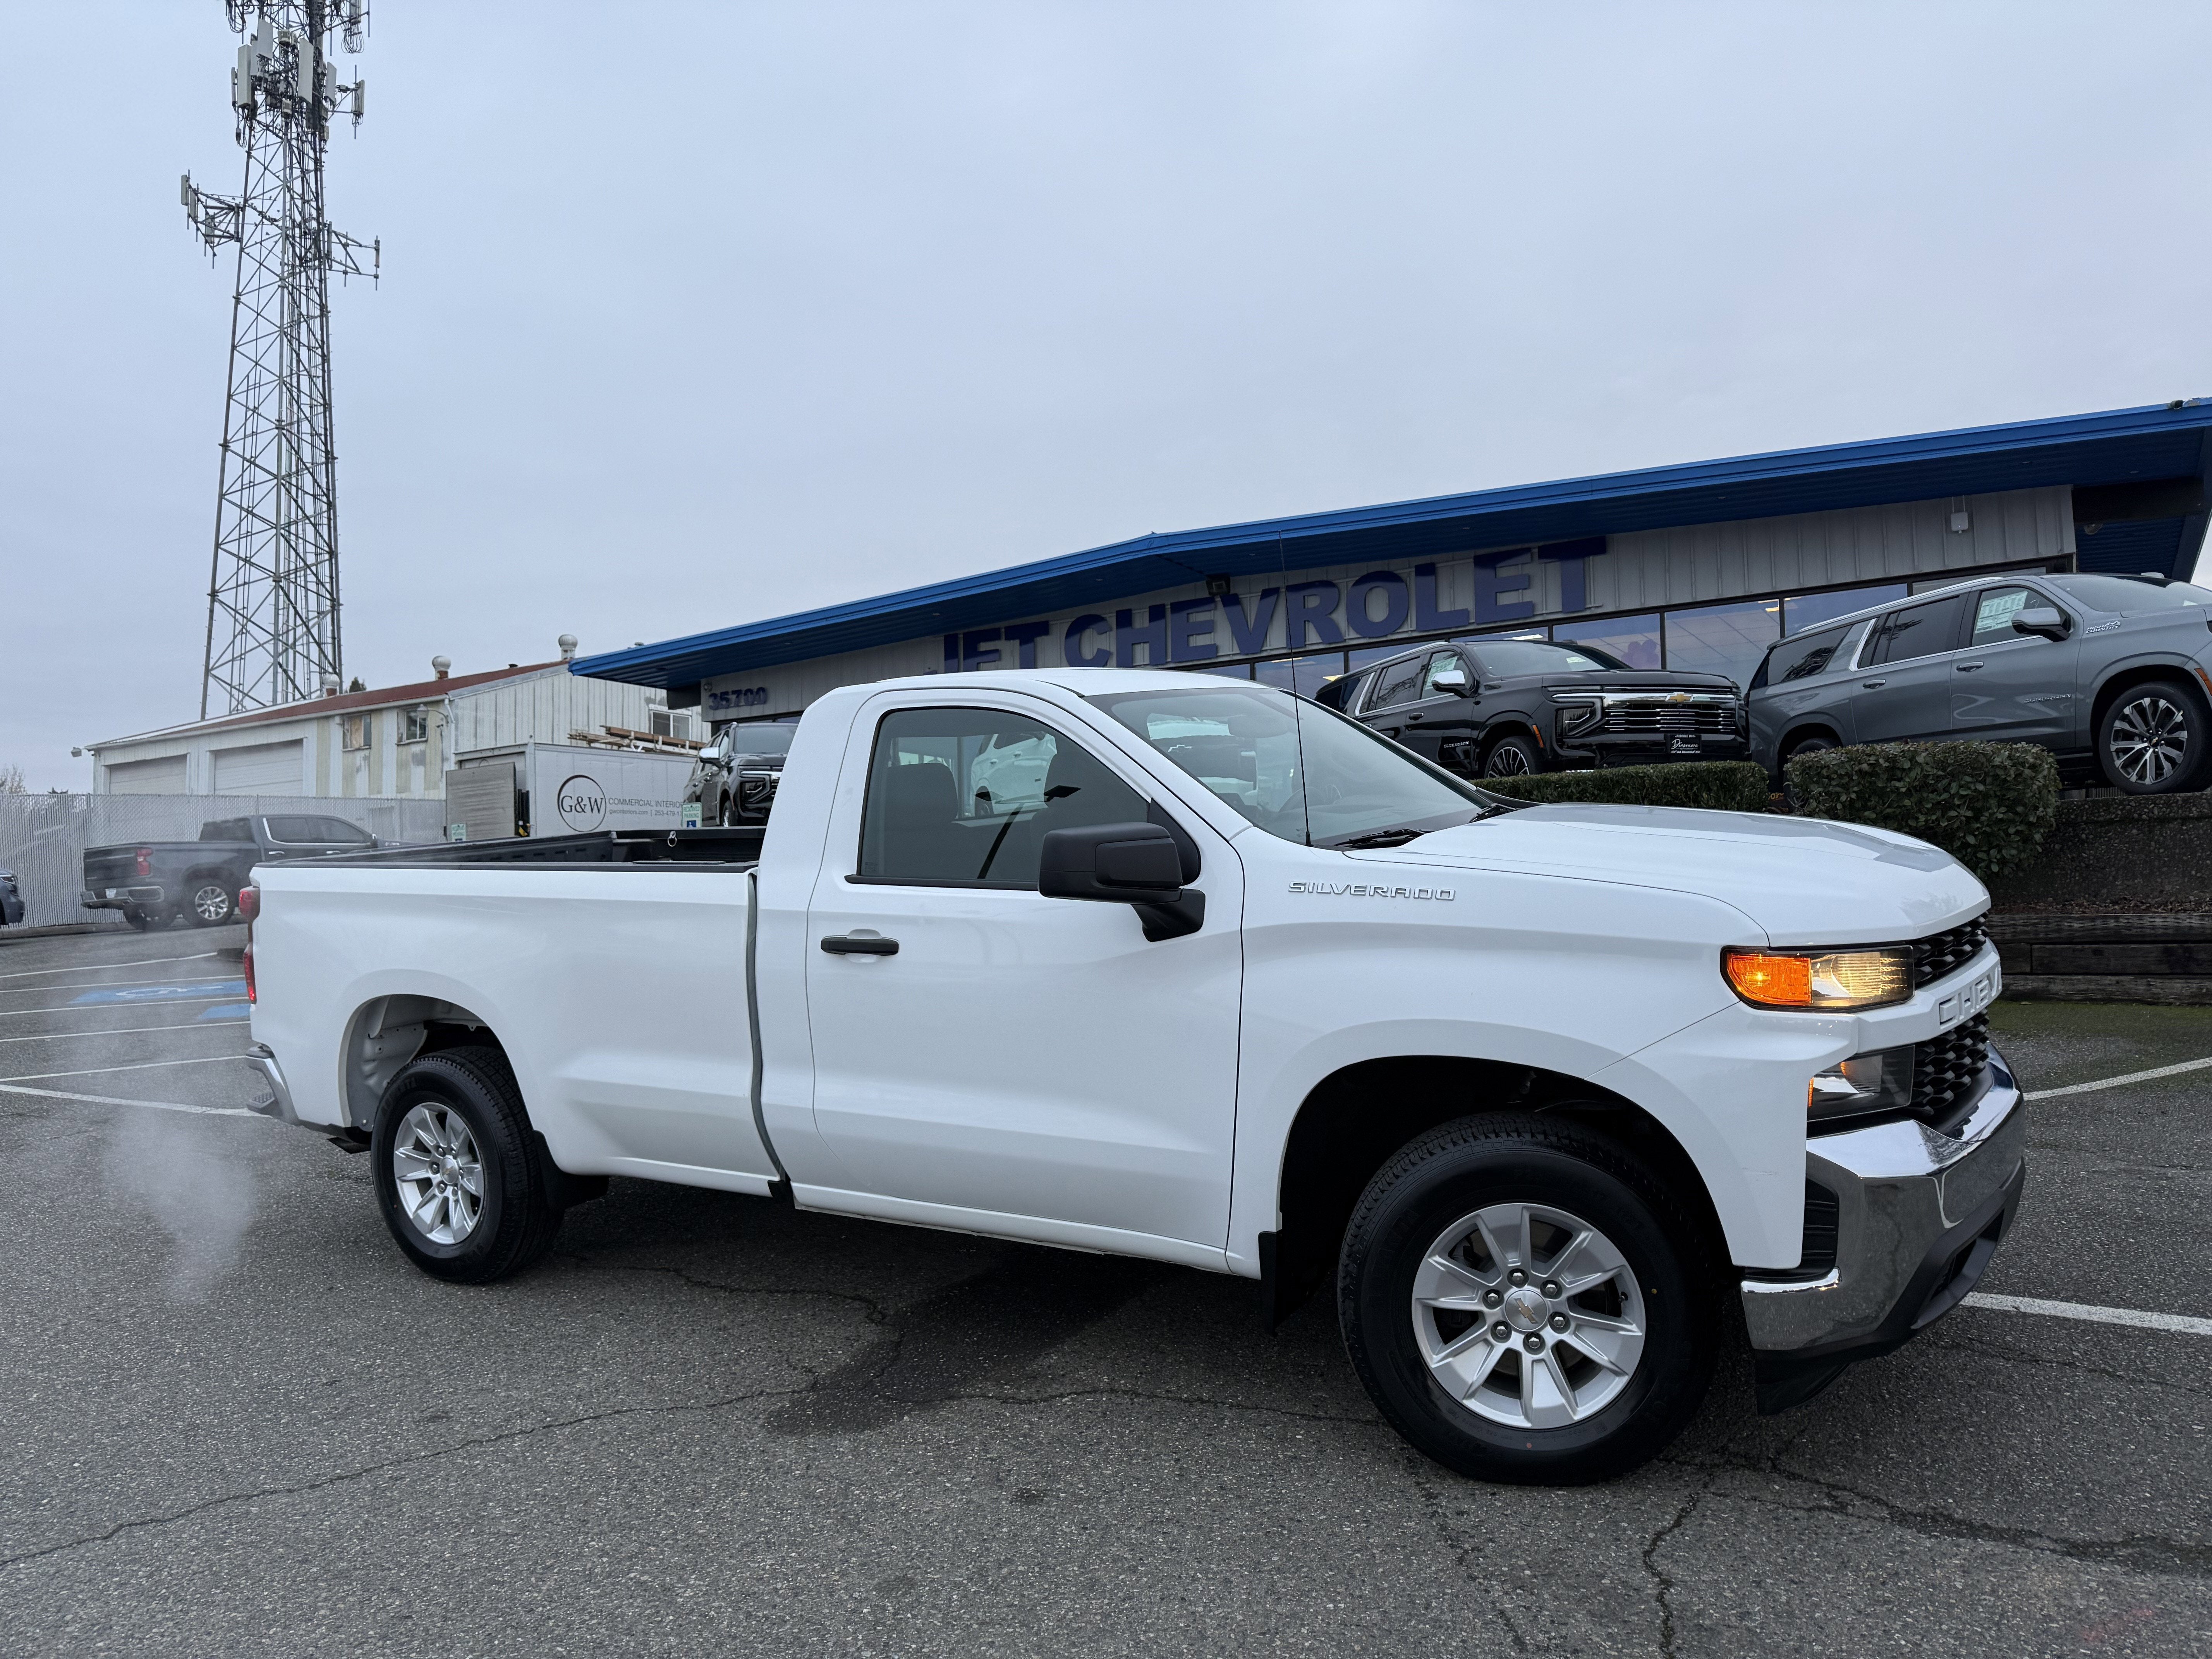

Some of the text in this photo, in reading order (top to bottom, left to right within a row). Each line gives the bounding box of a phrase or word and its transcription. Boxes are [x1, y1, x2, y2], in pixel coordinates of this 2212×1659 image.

[1064, 536, 1606, 668] CHEVROLET
[2086, 625, 2120, 634] COUNTRY
[709, 687, 767, 710] 35700
[561, 795, 603, 814] G&W
[609, 797, 654, 807] COMMERCIAL
[1288, 881, 1456, 901] SILVERADO
[1939, 967, 2002, 1029] CHEV
